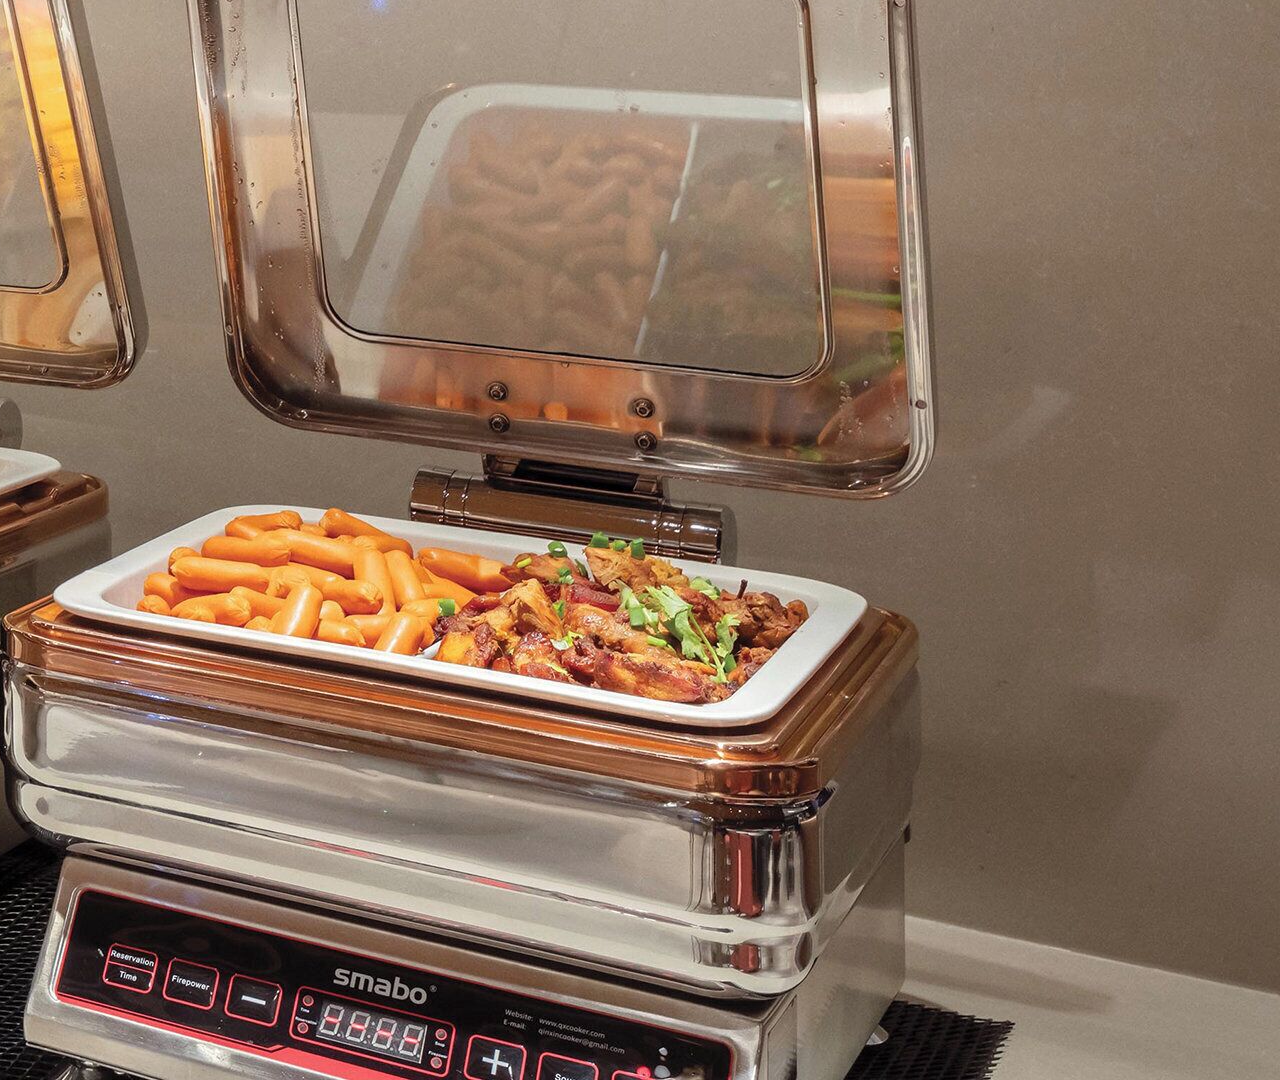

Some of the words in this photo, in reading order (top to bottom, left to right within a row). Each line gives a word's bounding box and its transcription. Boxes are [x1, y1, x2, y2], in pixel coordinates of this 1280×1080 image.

[110, 949, 155, 968] Reservation
[119, 970, 137, 983] Time
[171, 974, 210, 991] Firepower
[333, 967, 428, 1005] smabo
[504, 1009, 534, 1022] Website:
[503, 1018, 527, 1030] E-mail:
